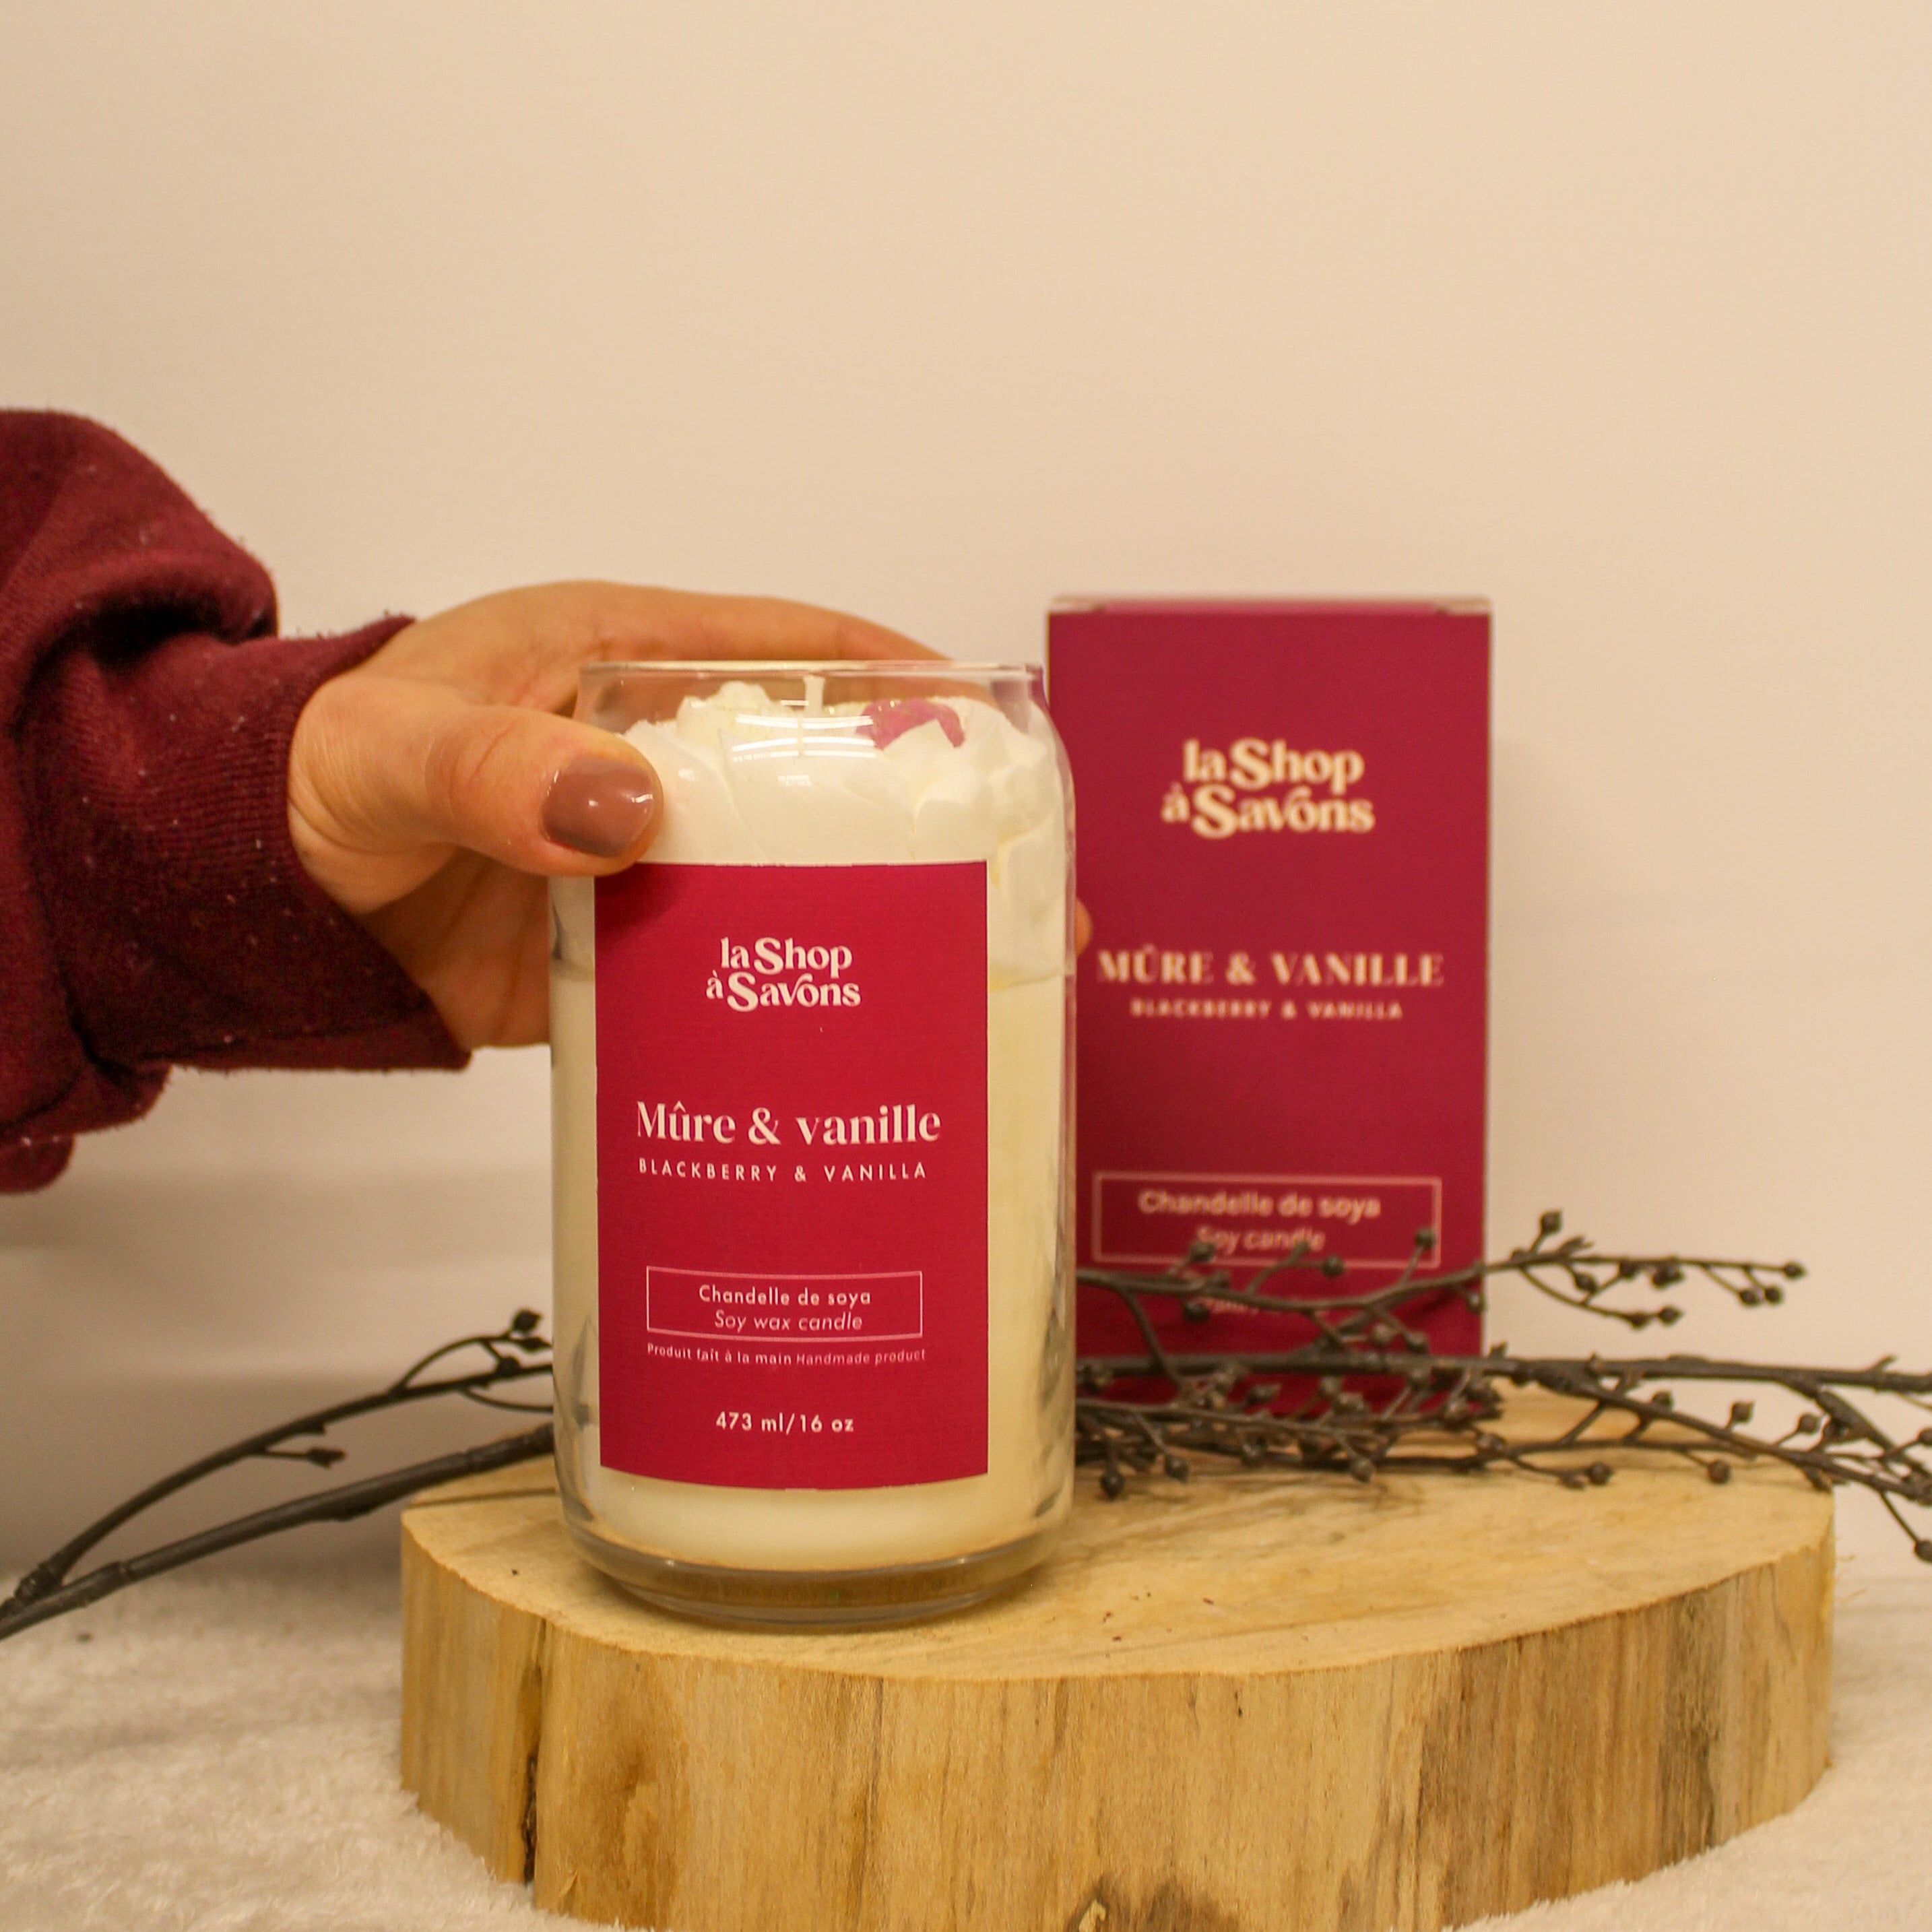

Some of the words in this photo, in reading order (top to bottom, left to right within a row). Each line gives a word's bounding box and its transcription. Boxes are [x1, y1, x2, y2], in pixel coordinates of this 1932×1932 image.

[1183, 739, 1227, 783] la
[1229, 739, 1365, 795] Shop
[1162, 783, 1190, 823] à
[1192, 784, 1376, 839] Savons
[721, 936, 750, 969] la
[754, 937, 853, 979] Shop
[1099, 944, 1214, 984] MÛRE
[1225, 953, 1255, 985] &
[1272, 953, 1444, 987] VANILLE
[706, 969, 723, 999] à
[728, 971, 861, 1012] Savons
[1132, 1000, 1270, 1017] BLACKBERRY
[1281, 1001, 1297, 1019] &
[1308, 1002, 1403, 1019] VANILLA
[637, 1100, 736, 1144] Mûre
[748, 1107, 781, 1145] &
[796, 1103, 940, 1145] vanille
[639, 1157, 777, 1182] BLACKBERRY
[794, 1165, 806, 1182] &
[824, 1160, 926, 1182] VANILLA
[1138, 1190, 1274, 1217] Chandelle
[1277, 1193, 1313, 1217] de
[1318, 1197, 1381, 1224] soya
[699, 1284, 790, 1306] Chandelle
[798, 1287, 820, 1306] de
[828, 1292, 870, 1309] soya
[714, 1309, 746, 1332] Soy
[754, 1317, 790, 1330] wax
[798, 1312, 862, 1330] candle
[647, 1343, 691, 1359] Produit
[697, 1347, 719, 1362] fait
[725, 1349, 732, 1363] à
[737, 1351, 750, 1363] la
[755, 1352, 792, 1365] main
[796, 1351, 870, 1366] Handmade
[874, 1348, 926, 1367] product
[715, 1411, 752, 1431] 473
[831, 1419, 854, 1432] oz
